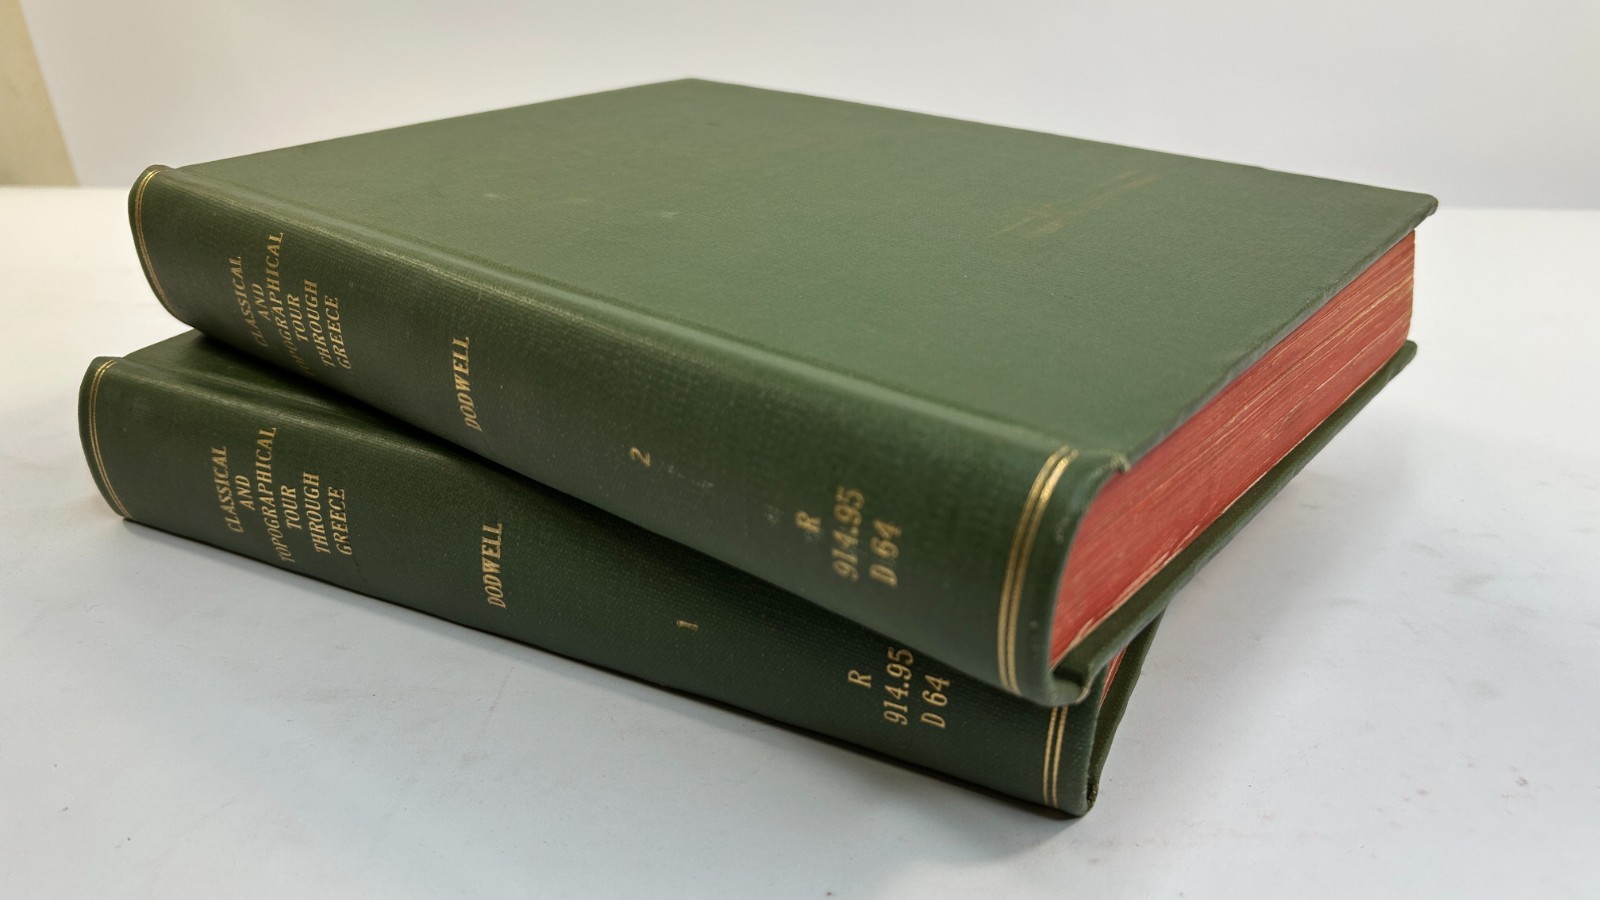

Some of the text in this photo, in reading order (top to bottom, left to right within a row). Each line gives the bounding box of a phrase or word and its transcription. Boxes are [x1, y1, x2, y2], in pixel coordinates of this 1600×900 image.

[229, 256, 268, 347] CLASSICAL
[252, 283, 271, 321] AND
[287, 293, 309, 342] TOUR
[304, 279, 336, 367] THROUGH
[324, 295, 351, 369] GREECE
[452, 337, 481, 431] DODWELL
[211, 446, 244, 533] CLASSICAL
[630, 447, 651, 466] 2
[235, 475, 255, 511] AND
[255, 427, 296, 562] TOPOGRAPHICAL
[280, 485, 302, 530] TOUR
[303, 472, 331, 554] THROUGH
[328, 487, 352, 555] GREECE
[795, 510, 821, 534] R
[481, 522, 507, 608] DODWELL
[831, 486, 865, 582] 914.95
[869, 519, 902, 586] D 64
[848, 669, 872, 688] R
[883, 647, 914, 725] 914.95
[920, 674, 951, 728] D 64
